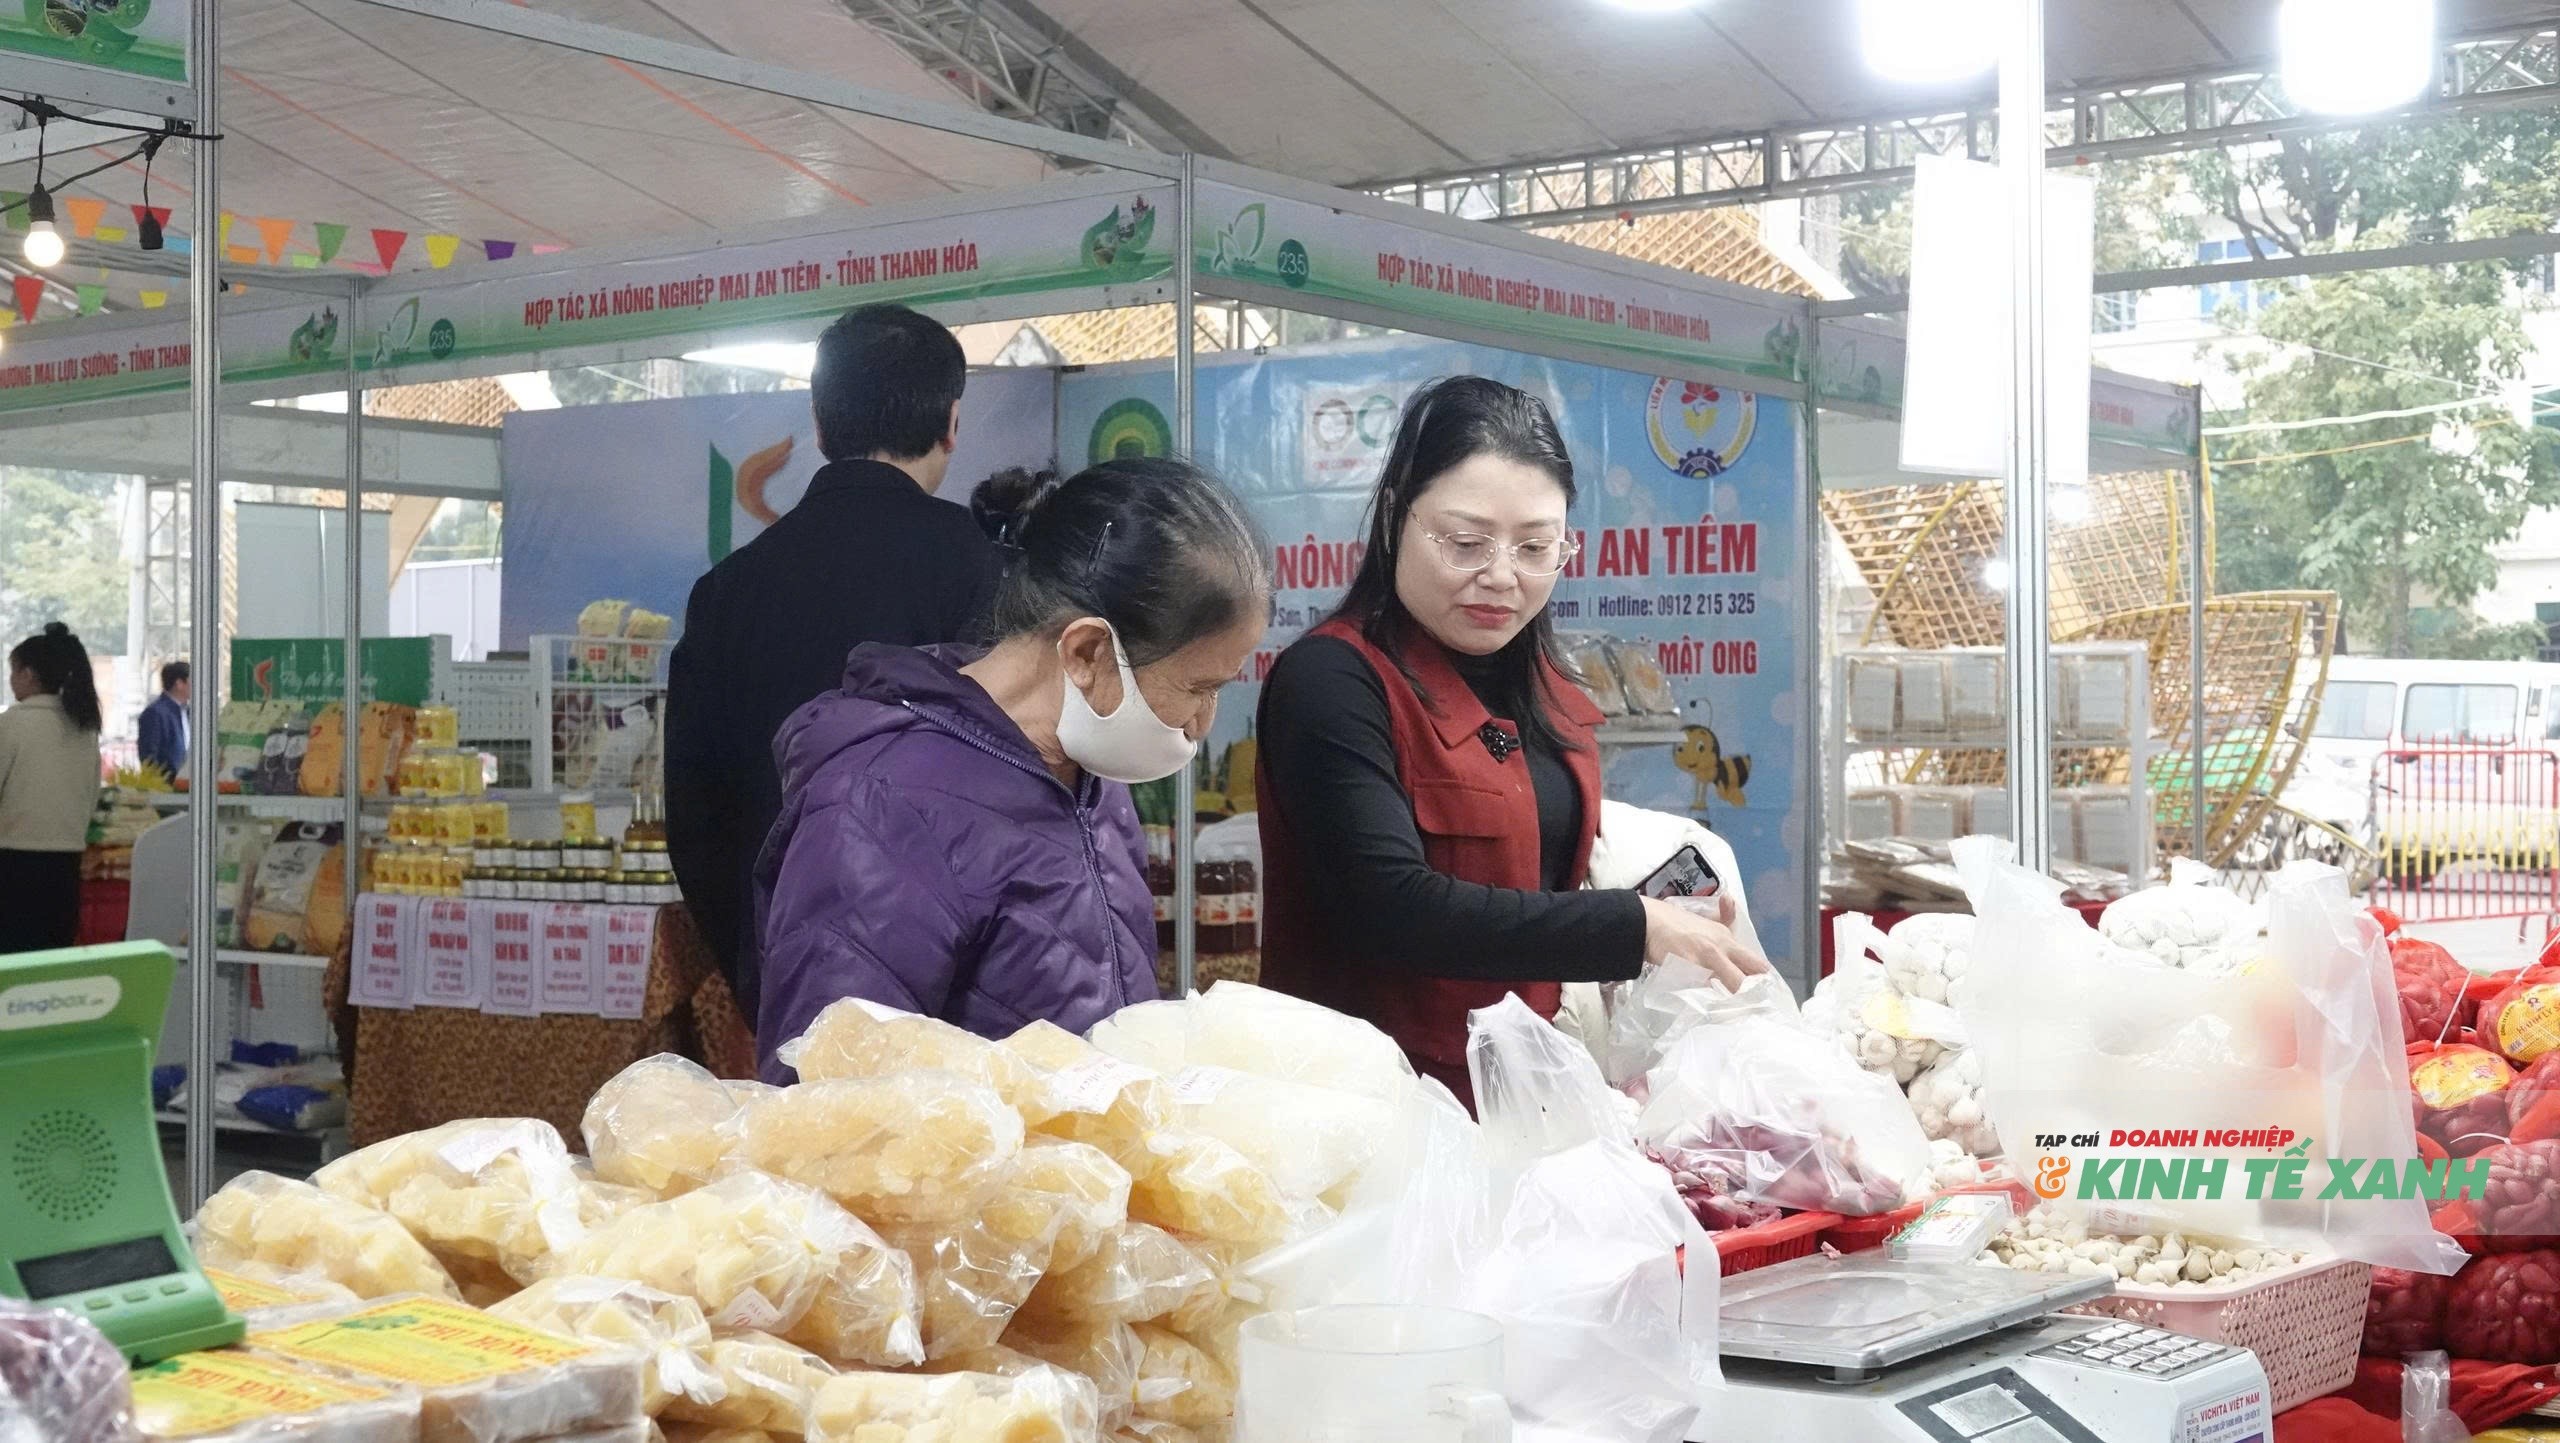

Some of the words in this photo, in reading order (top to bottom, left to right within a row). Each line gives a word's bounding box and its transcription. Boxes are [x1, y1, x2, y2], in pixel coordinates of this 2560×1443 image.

[1280, 251, 1305, 275] 235
[524, 297, 553, 330] HỢP
[558, 292, 584, 321] TÁC
[588, 288, 608, 320] XÃ
[612, 283, 654, 315] NÔNG
[658, 274, 714, 311] NGHIỆP
[719, 272, 749, 302] MAI
[755, 269, 777, 298] AN
[781, 260, 821, 294] TIÊM
[837, 250, 875, 287] TỈNH
[881, 248, 937, 281] THANH
[942, 238, 978, 273] HÓA
[1377, 252, 1405, 287] HỢP
[1409, 256, 1433, 289] TÁC
[1437, 263, 1454, 294] XÃ
[1458, 267, 1493, 302] NÔNG
[1496, 278, 1540, 314] NGHIỆP
[1543, 287, 1566, 316] MAI
[1569, 293, 1586, 319] AN
[1588, 294, 1615, 325] TIÊM
[1625, 297, 1650, 331] TỈNH
[1652, 309, 1688, 340] THANH
[431, 329, 453, 350] 235
[1597, 528, 1650, 577] AN
[1662, 514, 1757, 575] TIÊM
[1599, 594, 1653, 618] Hotline:
[1657, 593, 1692, 617] 0912
[1697, 592, 1723, 616] 215
[1728, 592, 1756, 615] 325
[1658, 635, 1704, 682] MẬT
[1712, 640, 1758, 675] ONG
[2200, 1403, 2227, 1422] VICHITA
[2229, 1396, 2243, 1412] VIỆT
[2245, 1391, 2260, 1405] NAM
